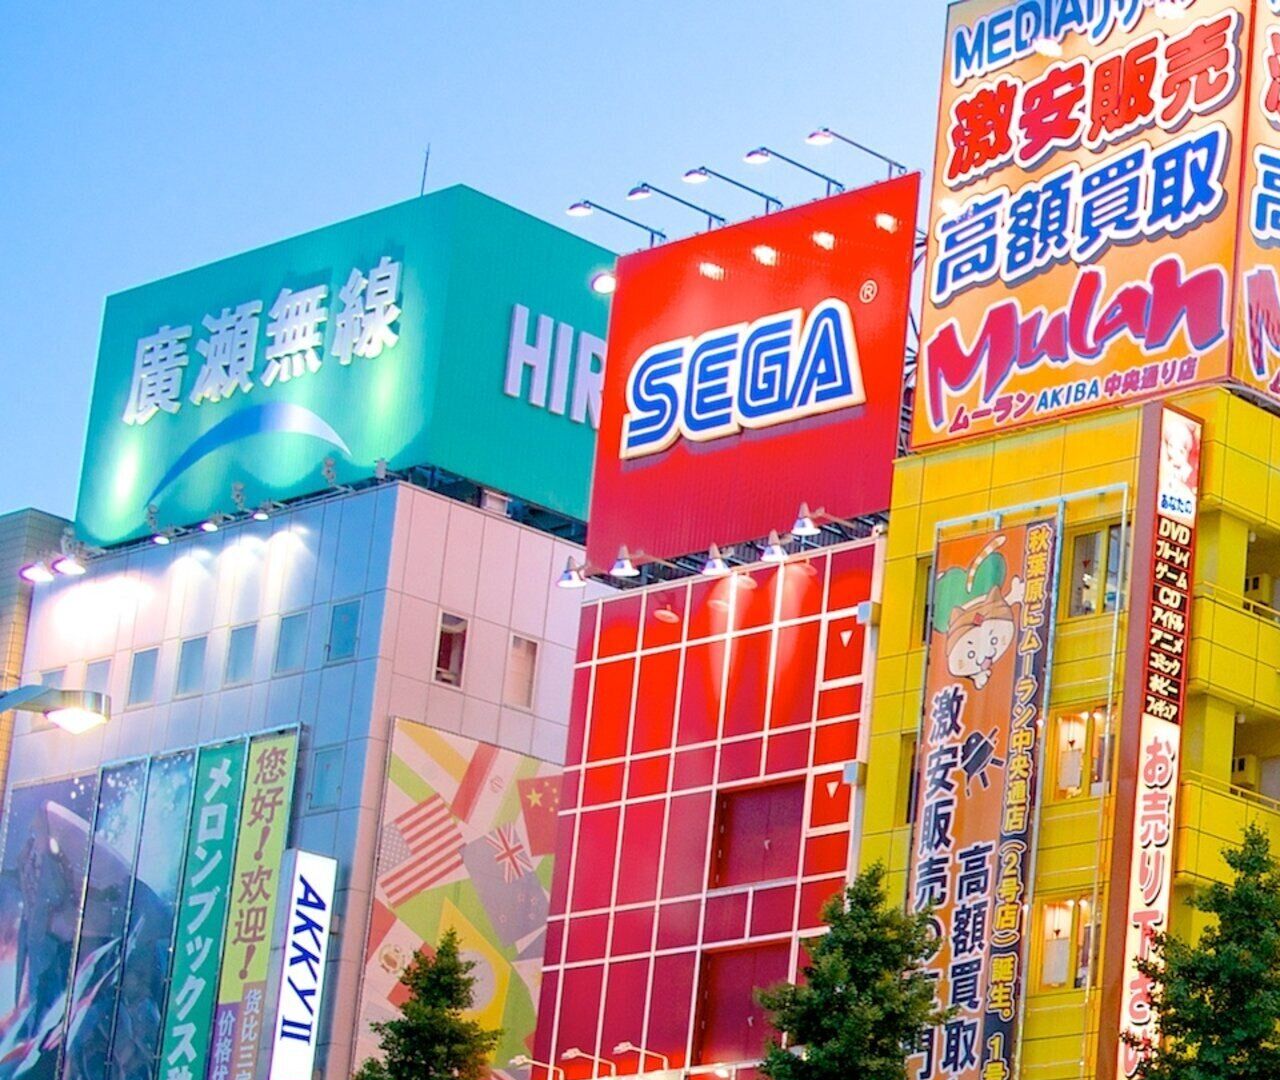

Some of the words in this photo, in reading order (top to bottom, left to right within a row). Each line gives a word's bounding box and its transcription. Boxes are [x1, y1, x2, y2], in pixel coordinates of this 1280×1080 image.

[946, 12, 1242, 180] 激安販売
[931, 124, 1226, 304] 高額買取
[122, 256, 404, 425] 廣瀬無線
[503, 304, 607, 430] HIR
[620, 299, 865, 458] SEGA
[923, 262, 1228, 431] Mulan
[948, 390, 1035, 434] ムーラン
[1036, 379, 1099, 412] AKIBA
[1103, 356, 1198, 400] 中央通り店
[1158, 518, 1191, 545] DVD
[1160, 494, 1193, 513] あなたの
[1154, 564, 1188, 590] ゲーム
[1158, 587, 1182, 609] CD
[1149, 631, 1184, 654] アニメ
[285, 874, 327, 1010] AKKY
